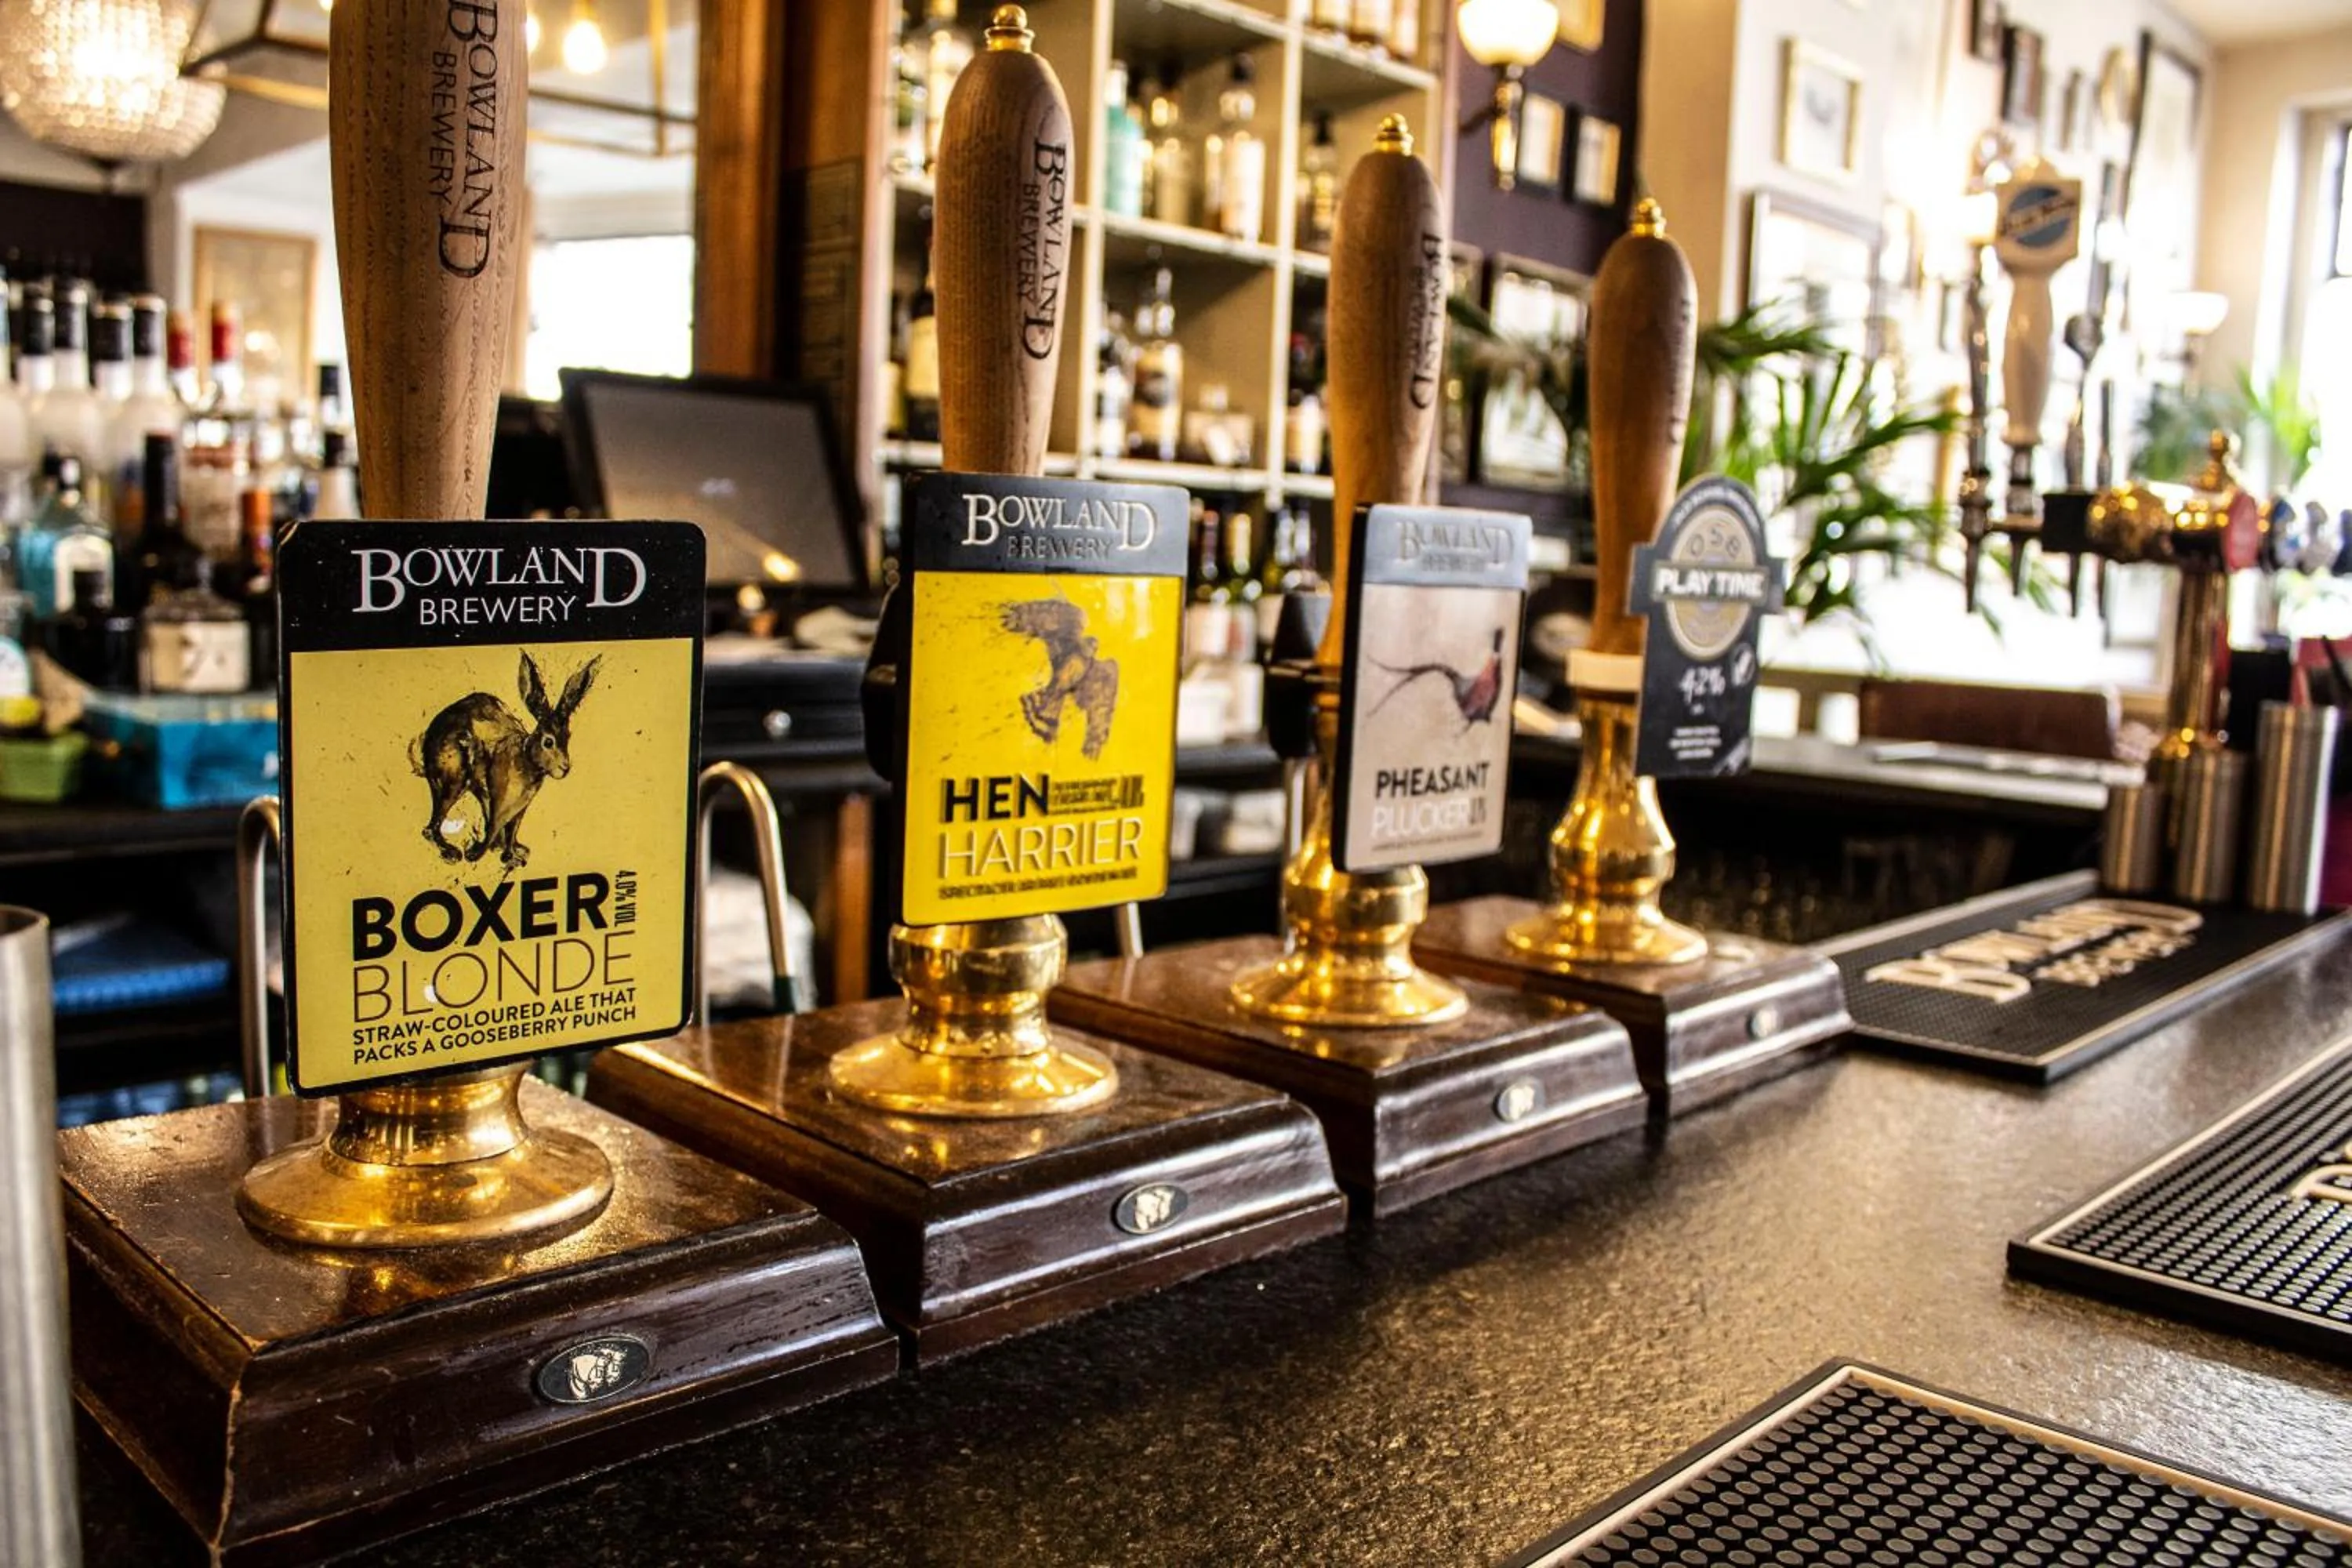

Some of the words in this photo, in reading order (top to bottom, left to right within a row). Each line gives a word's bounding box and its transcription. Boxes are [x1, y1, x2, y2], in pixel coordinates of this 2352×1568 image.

[429, 51, 456, 205] BREWERY
[439, 0, 498, 278] BOWLAND
[1018, 183, 1041, 306] BREWERY
[1023, 138, 1066, 359] BOWLAND
[961, 494, 1158, 550] BOWLAND
[1007, 535, 1112, 560] BREWERY
[350, 547, 647, 612] BOWLAND
[419, 595, 577, 626] BREWERY
[941, 772, 1049, 823] HEN
[1375, 760, 1490, 798] PHEASANT
[939, 816, 1143, 879] HARRIER
[353, 873, 609, 961] BOXER
[614, 902, 636, 927] VOL
[354, 931, 635, 1022] BLONDE
[354, 1002, 546, 1045] STRAW-COLOURED
[550, 995, 586, 1015] ALE
[590, 987, 637, 1008] THAT
[354, 1040, 418, 1065] PACKS
[422, 1038, 436, 1054] A
[441, 1015, 568, 1050] GOOSEBERRY
[573, 1006, 637, 1029] PUNCH
